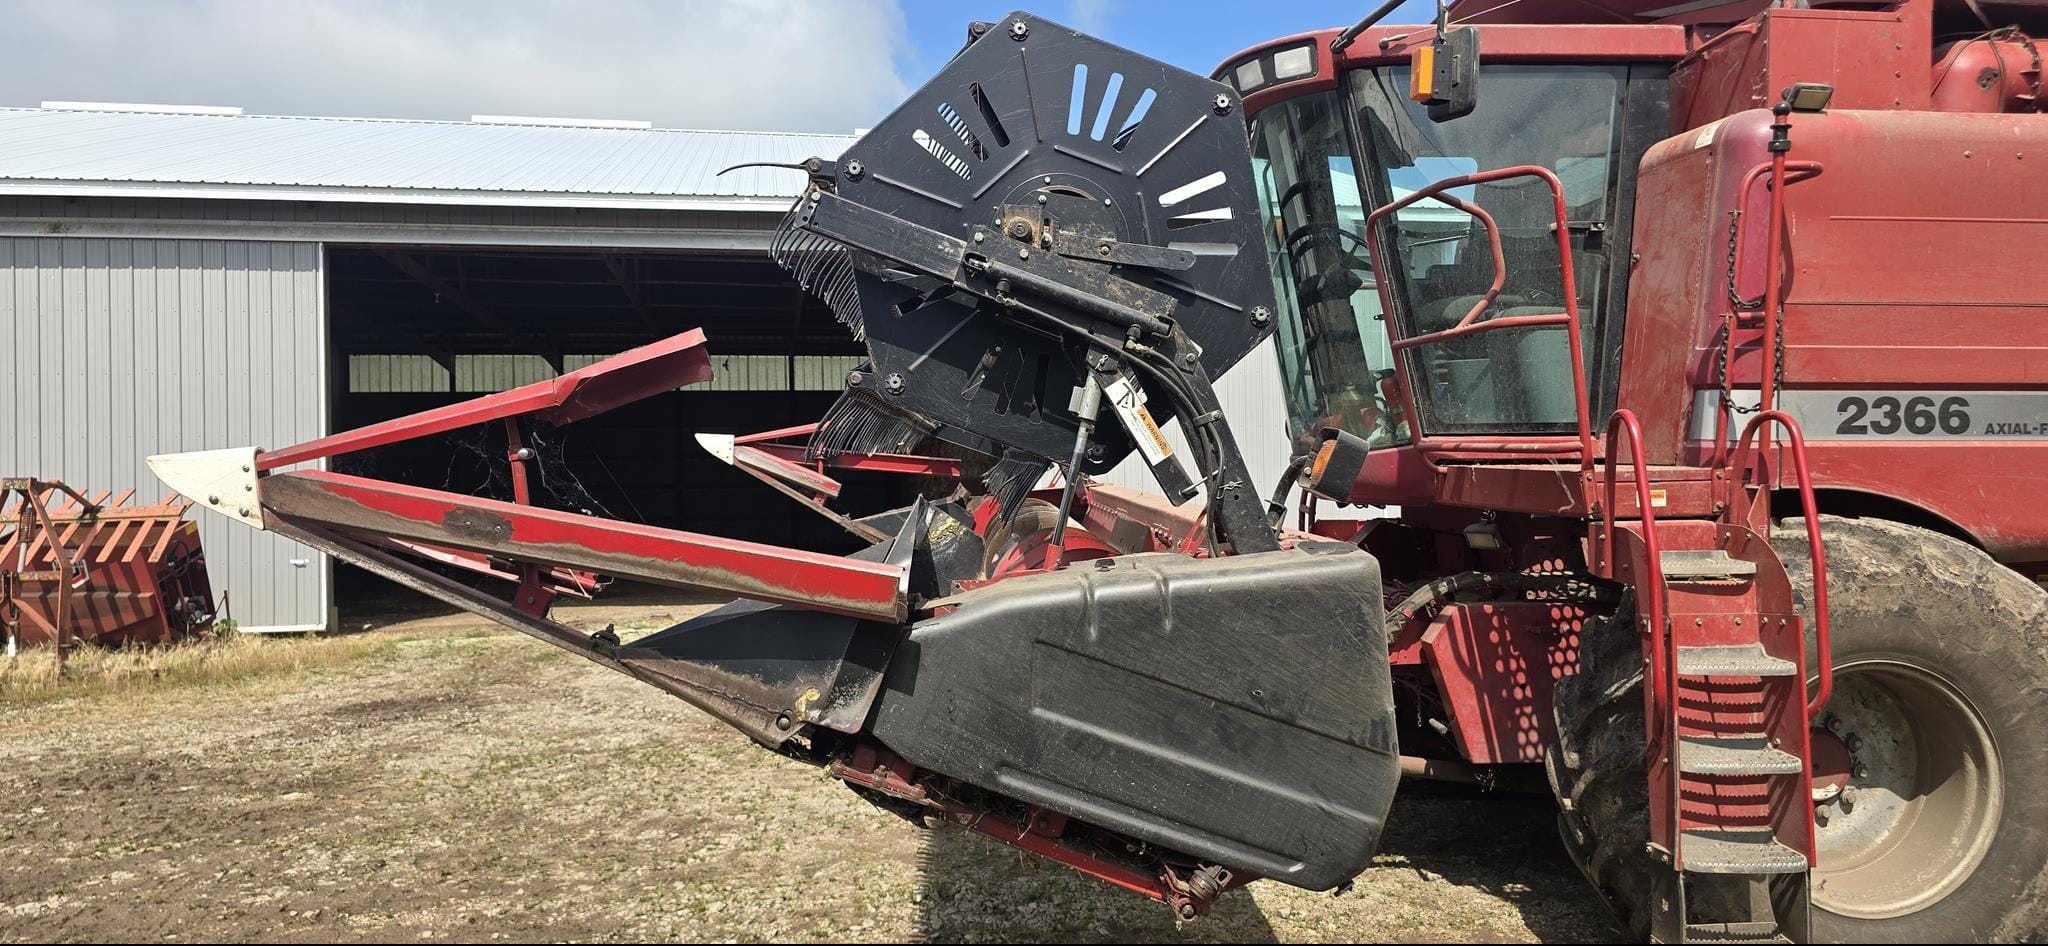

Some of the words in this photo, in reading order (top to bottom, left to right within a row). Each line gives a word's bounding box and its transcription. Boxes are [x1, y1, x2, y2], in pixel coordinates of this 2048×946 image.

[1836, 396, 1970, 435] 2366
[1984, 422, 2048, 435] AXIAL-F
[1145, 421, 1167, 450] WARNING
